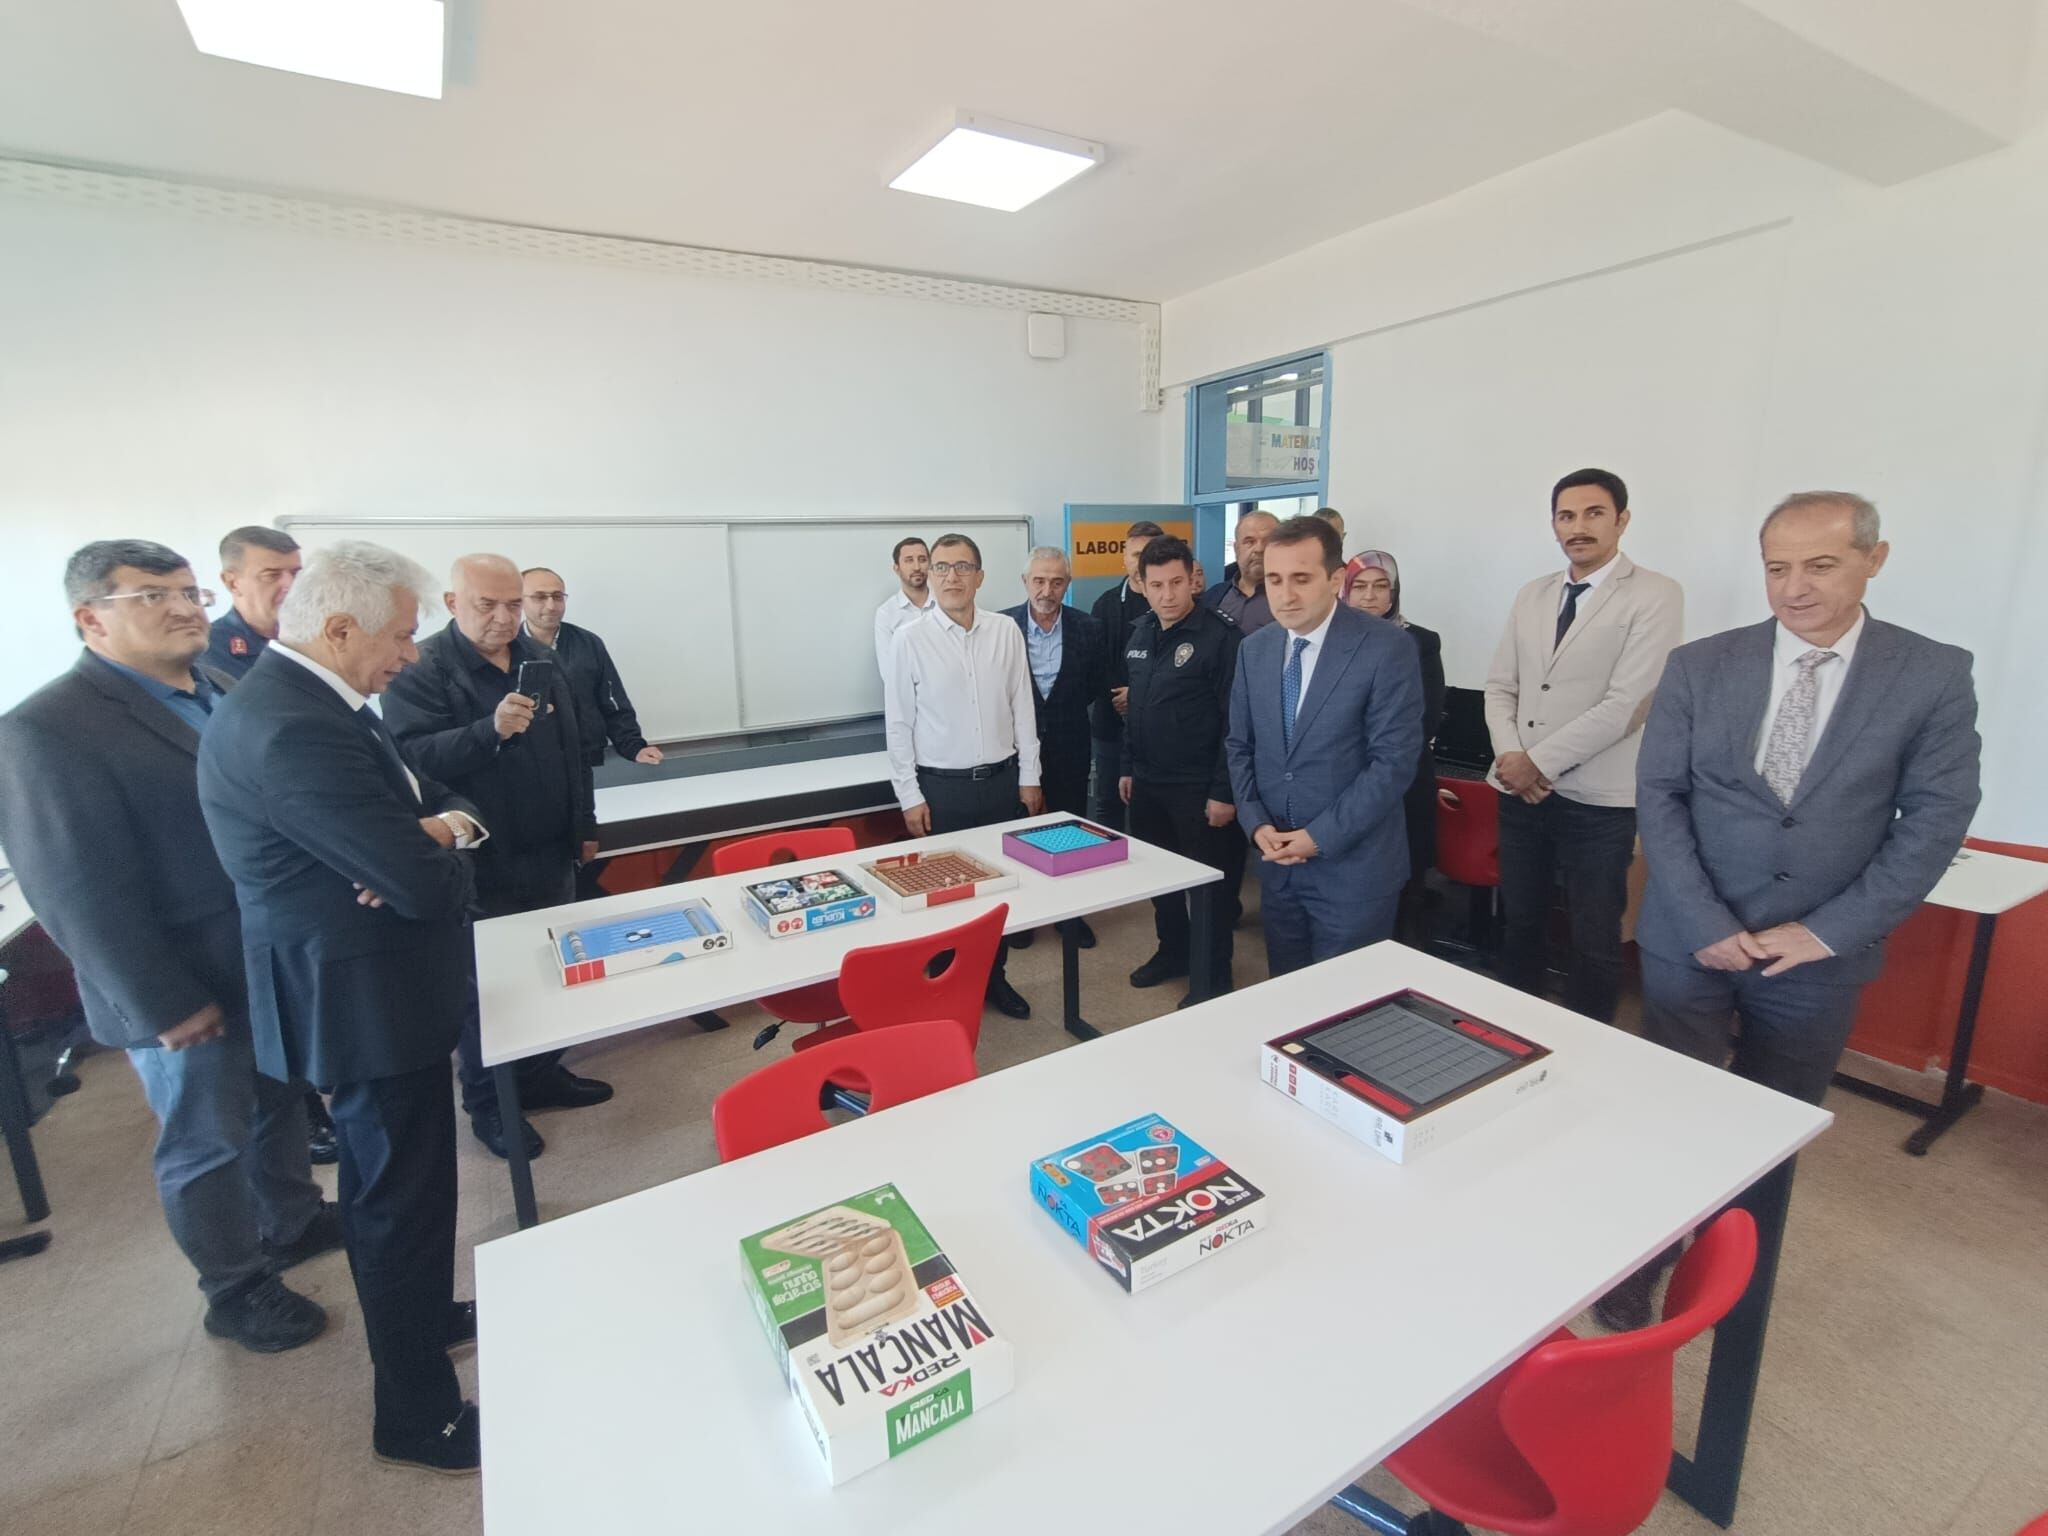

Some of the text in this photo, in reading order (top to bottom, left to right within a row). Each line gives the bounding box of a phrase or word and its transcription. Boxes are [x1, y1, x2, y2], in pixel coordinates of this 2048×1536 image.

[1293, 456, 1315, 475] HOŞ
[1111, 1175, 1246, 1242] NOKTA
[1199, 1219, 1255, 1256] NOKTA
[878, 1351, 961, 1398] REDKA
[895, 1390, 965, 1445] MANCALA
